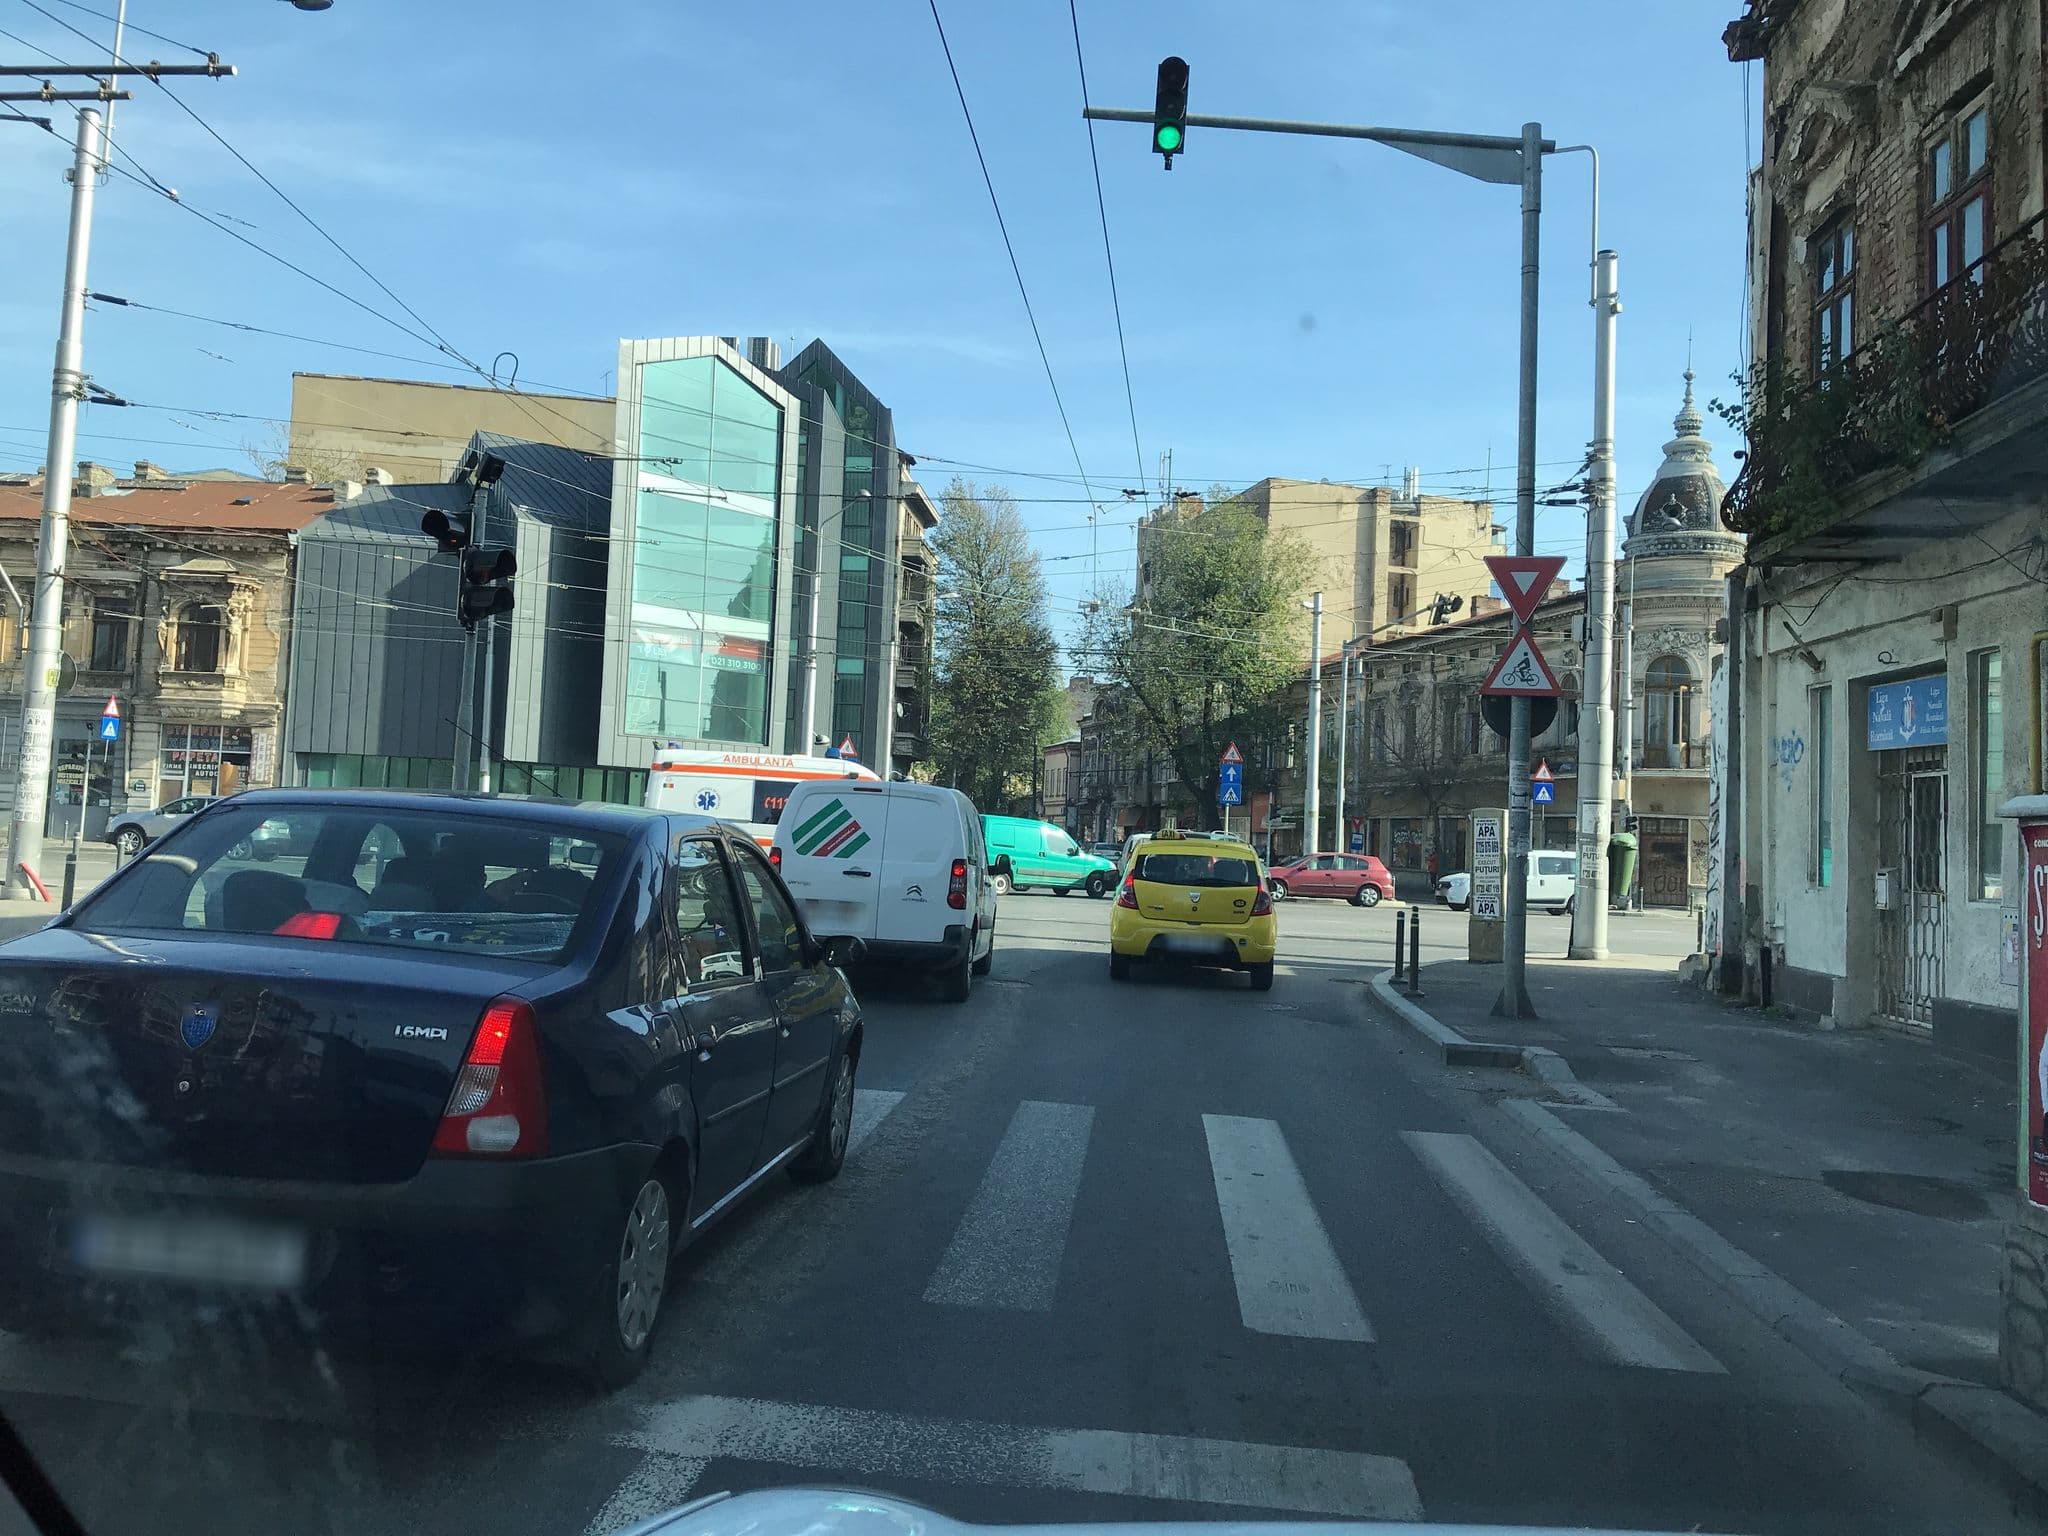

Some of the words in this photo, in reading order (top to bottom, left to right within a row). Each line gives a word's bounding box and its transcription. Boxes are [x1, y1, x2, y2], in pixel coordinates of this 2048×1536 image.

[1161, 830, 1175, 838] TAXI
[1478, 826, 1496, 837] APA
[1477, 903, 1496, 914] APA
